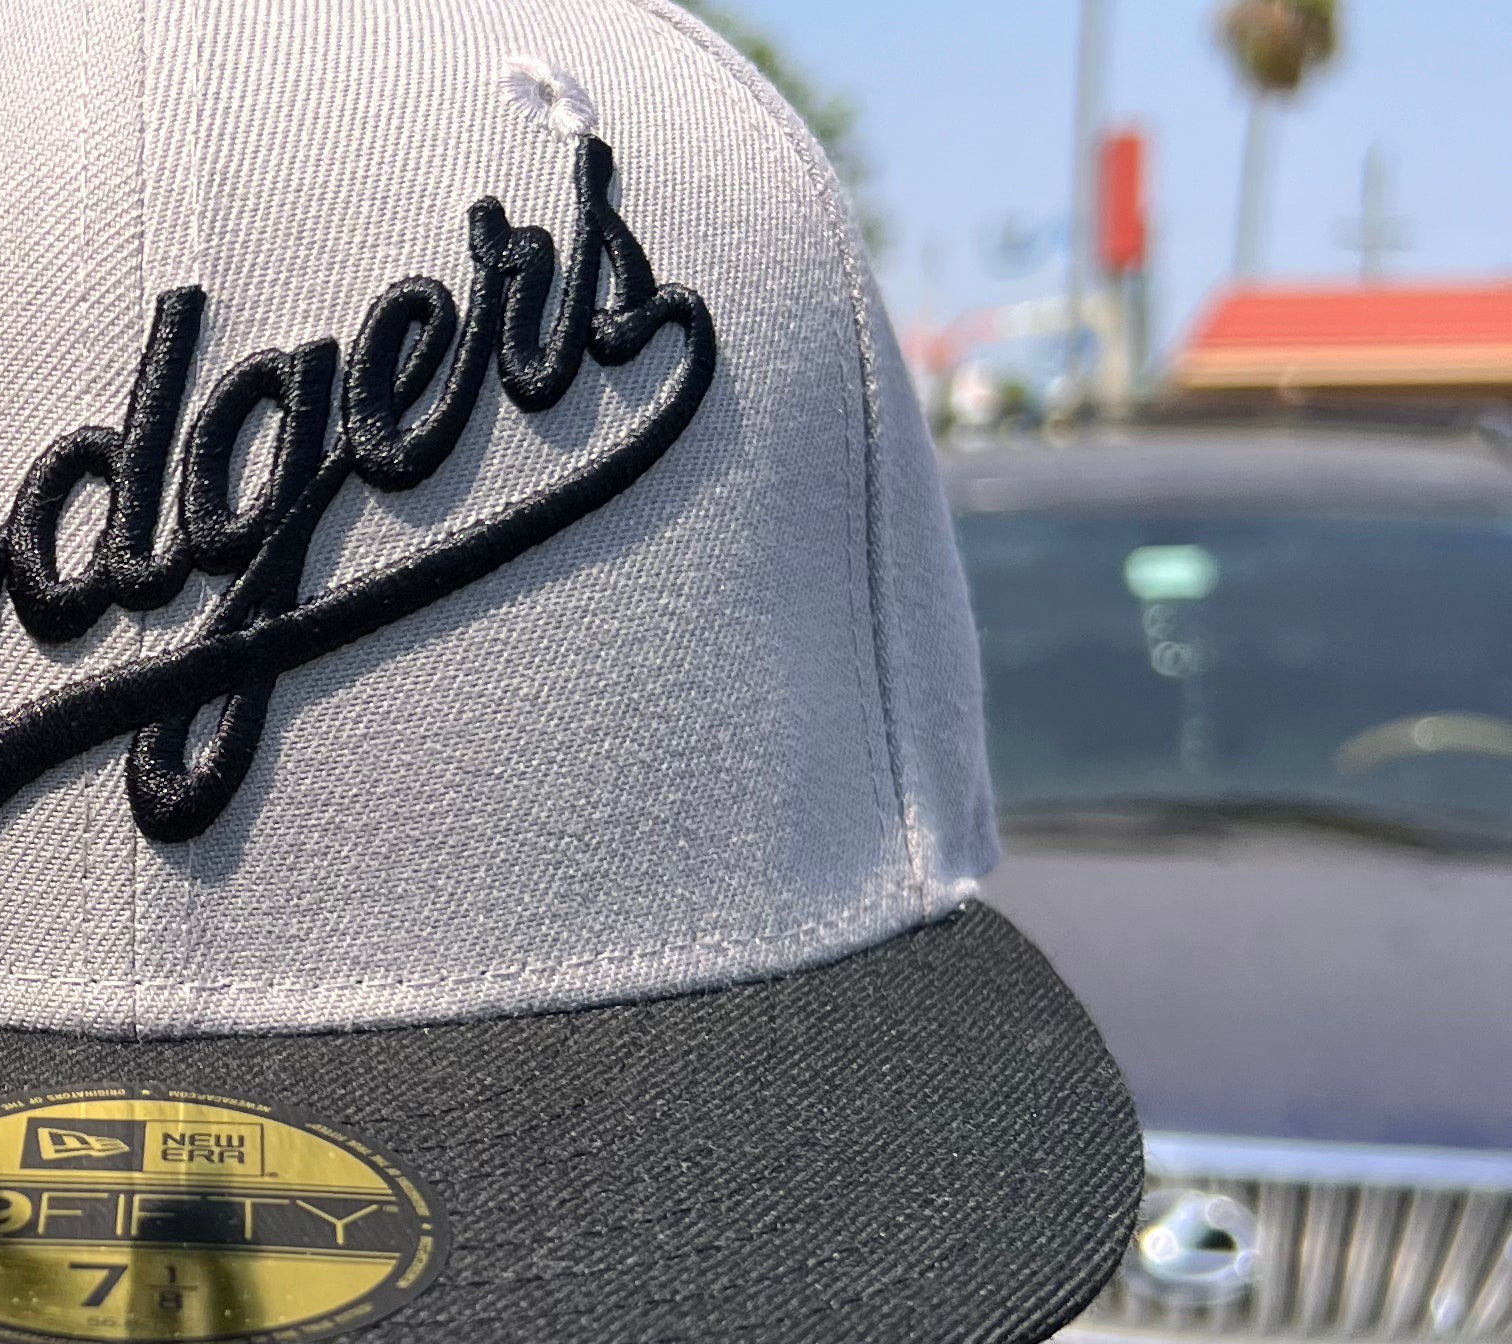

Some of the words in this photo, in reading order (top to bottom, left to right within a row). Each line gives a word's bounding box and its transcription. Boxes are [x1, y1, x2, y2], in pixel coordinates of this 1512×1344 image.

[162, 1132, 245, 1148] NEW
[161, 1148, 245, 1164] ERA
[68, 1261, 129, 1308] 7
